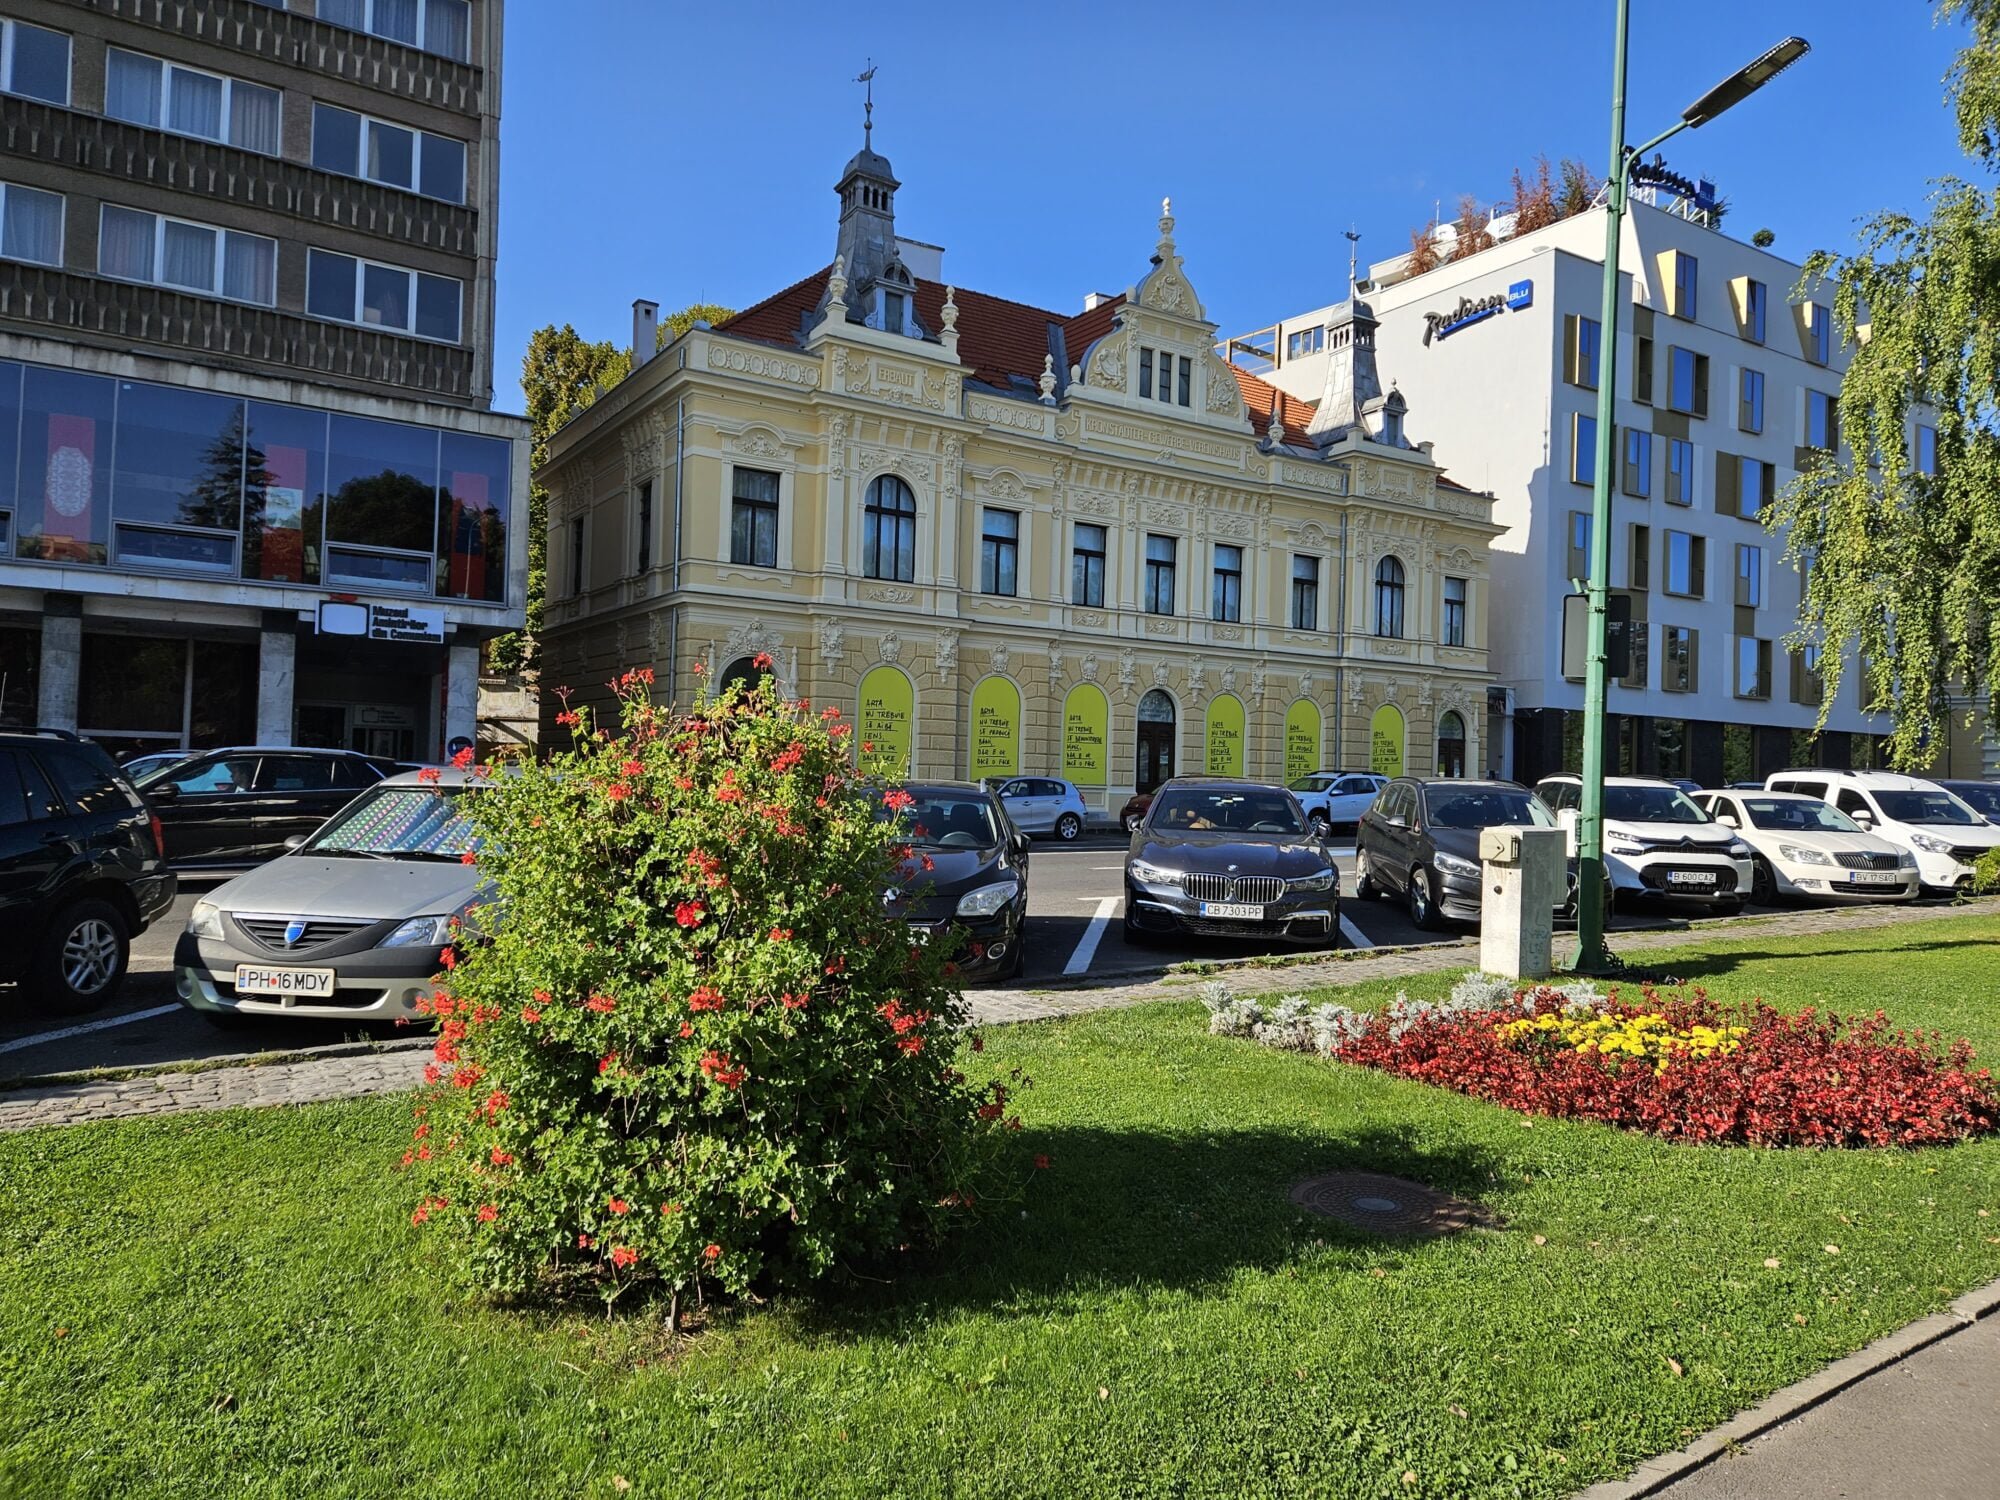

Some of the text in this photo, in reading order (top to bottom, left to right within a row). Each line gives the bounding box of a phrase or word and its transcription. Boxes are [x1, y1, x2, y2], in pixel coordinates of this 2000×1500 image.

[1422, 294, 1507, 349] Radisson
[878, 368, 914, 386] ERBAUT
[372, 628, 388, 638] din
[866, 699, 883, 708] ARTA
[878, 711, 904, 720] TREBUIE
[990, 719, 1010, 728] TREBUIE
[1698, 873, 1714, 882] CAZ
[1207, 904, 1262, 916] CB 7303 PP
[248, 971, 329, 991] PH 16 MDY
